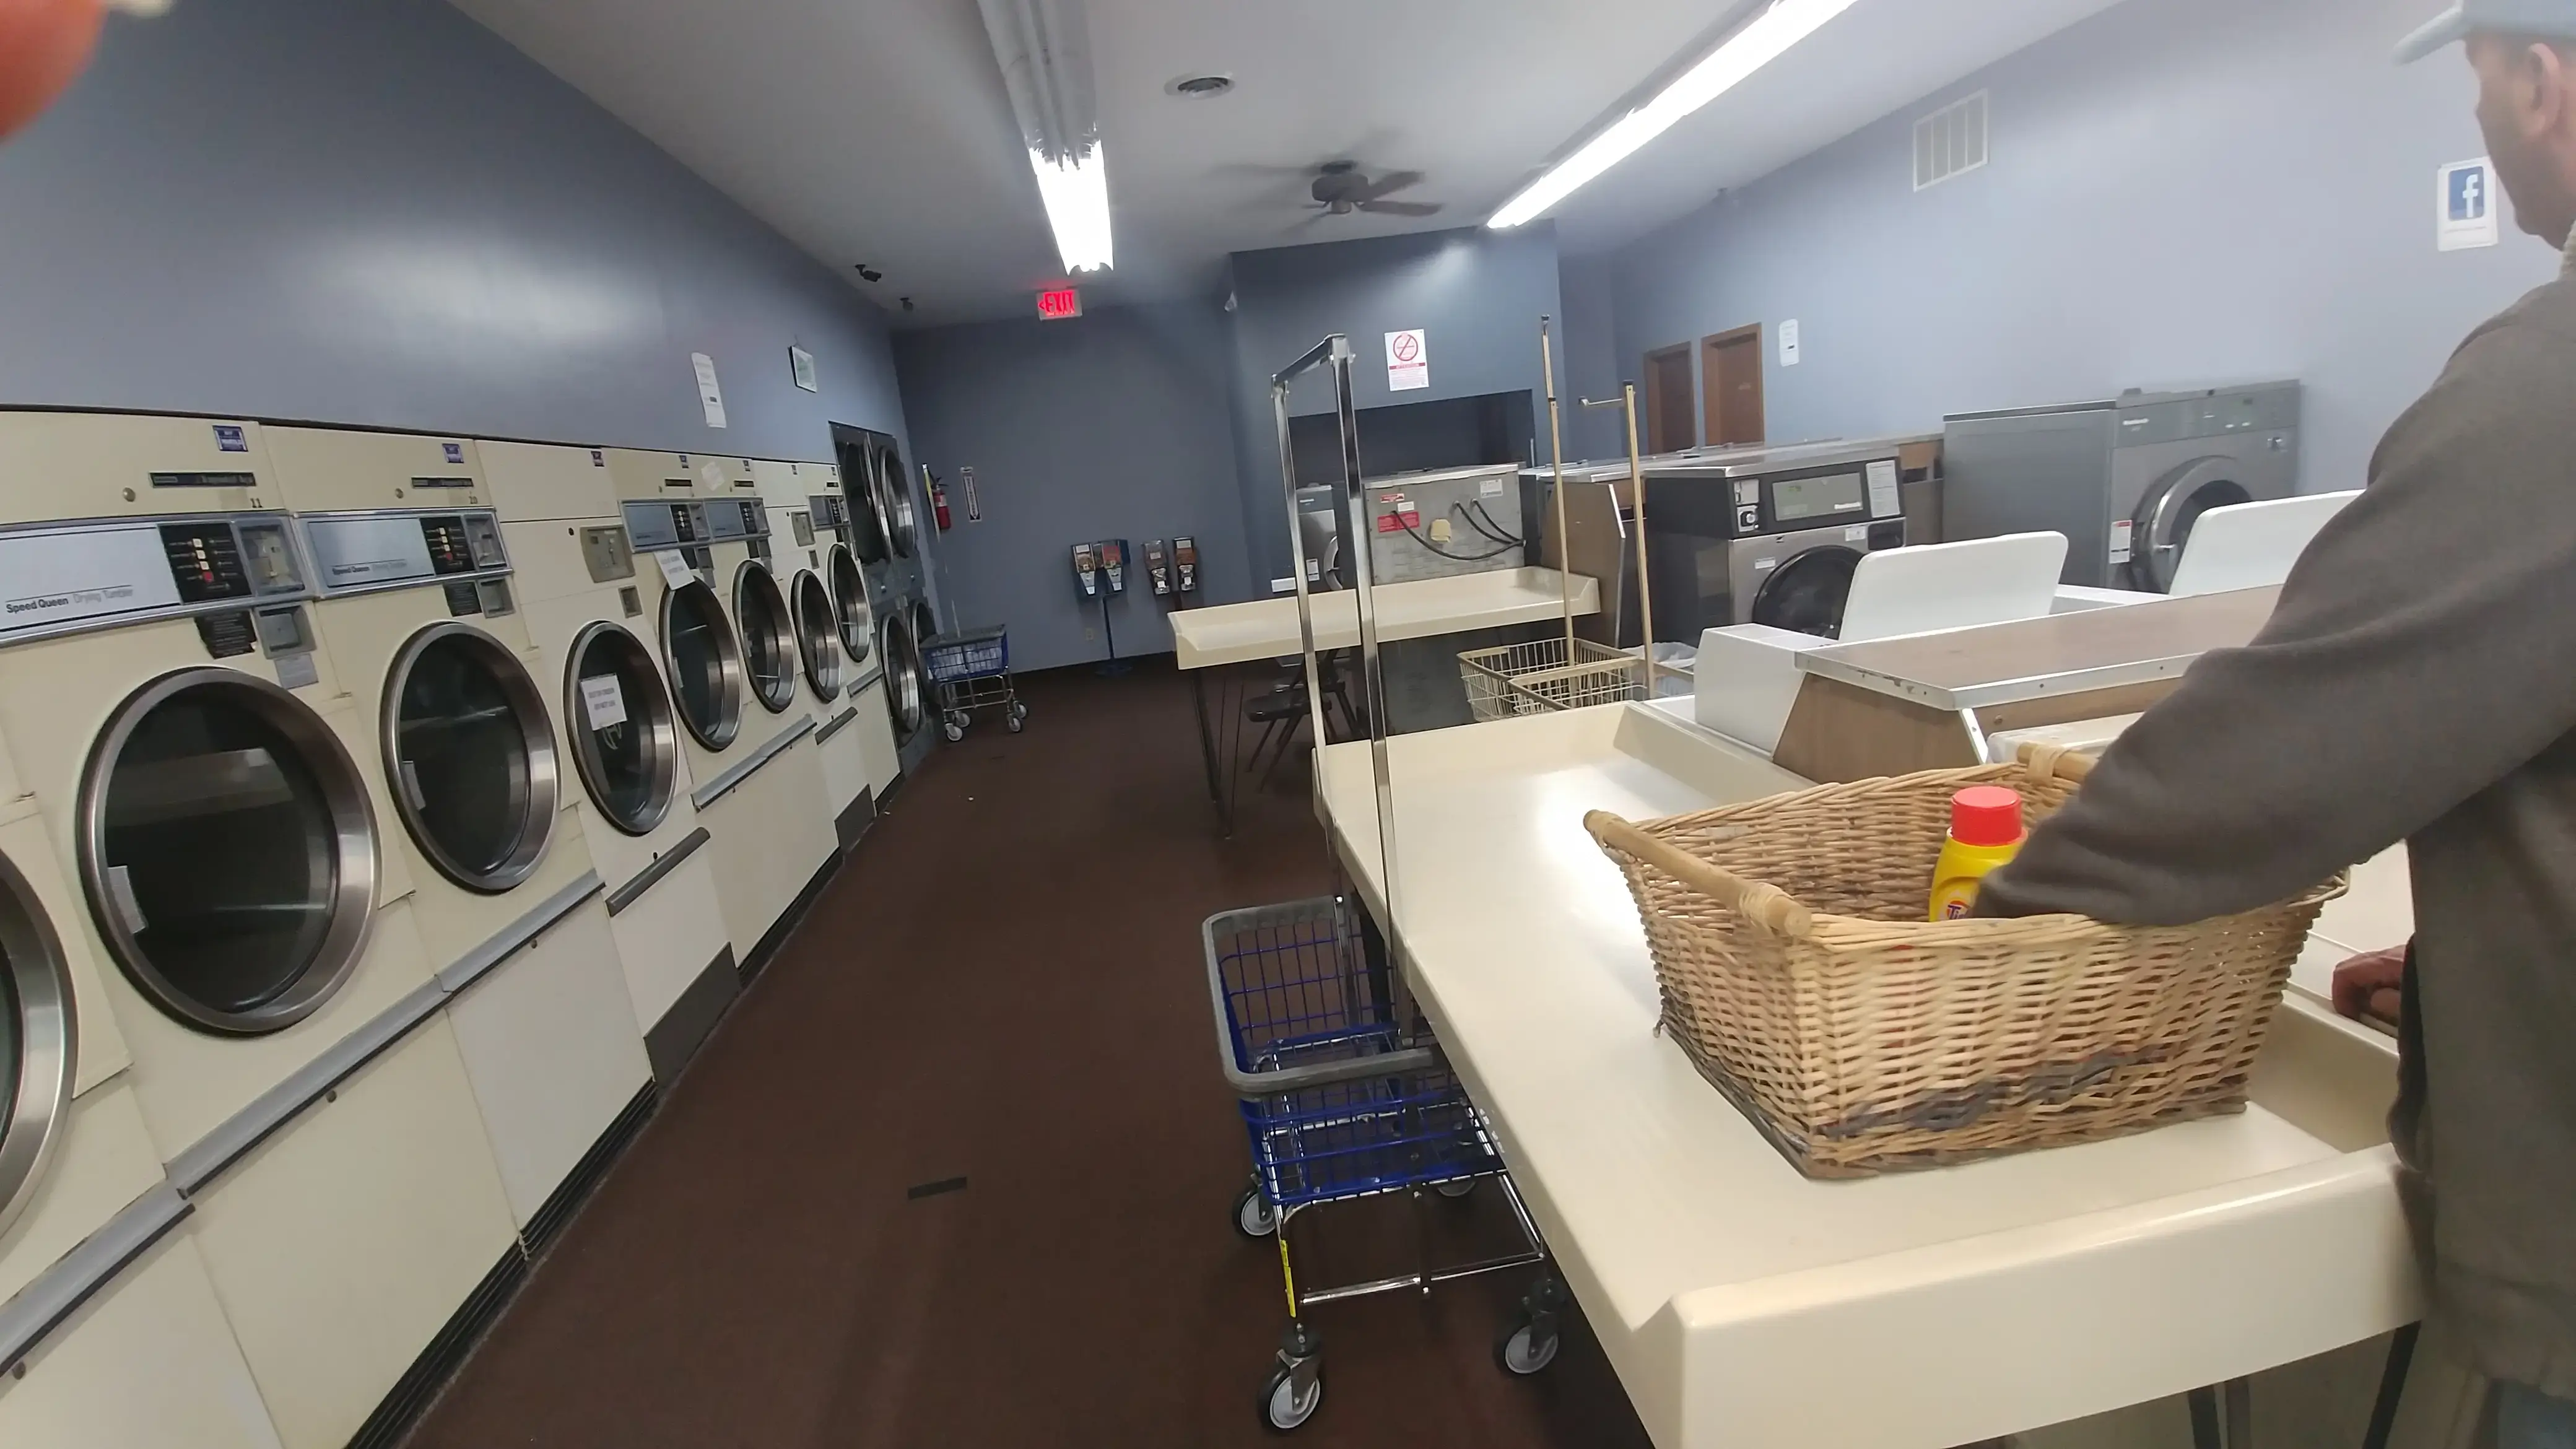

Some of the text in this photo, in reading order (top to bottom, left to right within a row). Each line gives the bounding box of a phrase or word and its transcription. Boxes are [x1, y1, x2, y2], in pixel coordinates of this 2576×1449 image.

[2462, 174, 2479, 217] f
[1043, 290, 1074, 315] EXIT
[250, 498, 263, 508] 11
[6, 601, 37, 614] Speed
[38, 597, 69, 608] Queen
[1947, 904, 1965, 920] Ti
